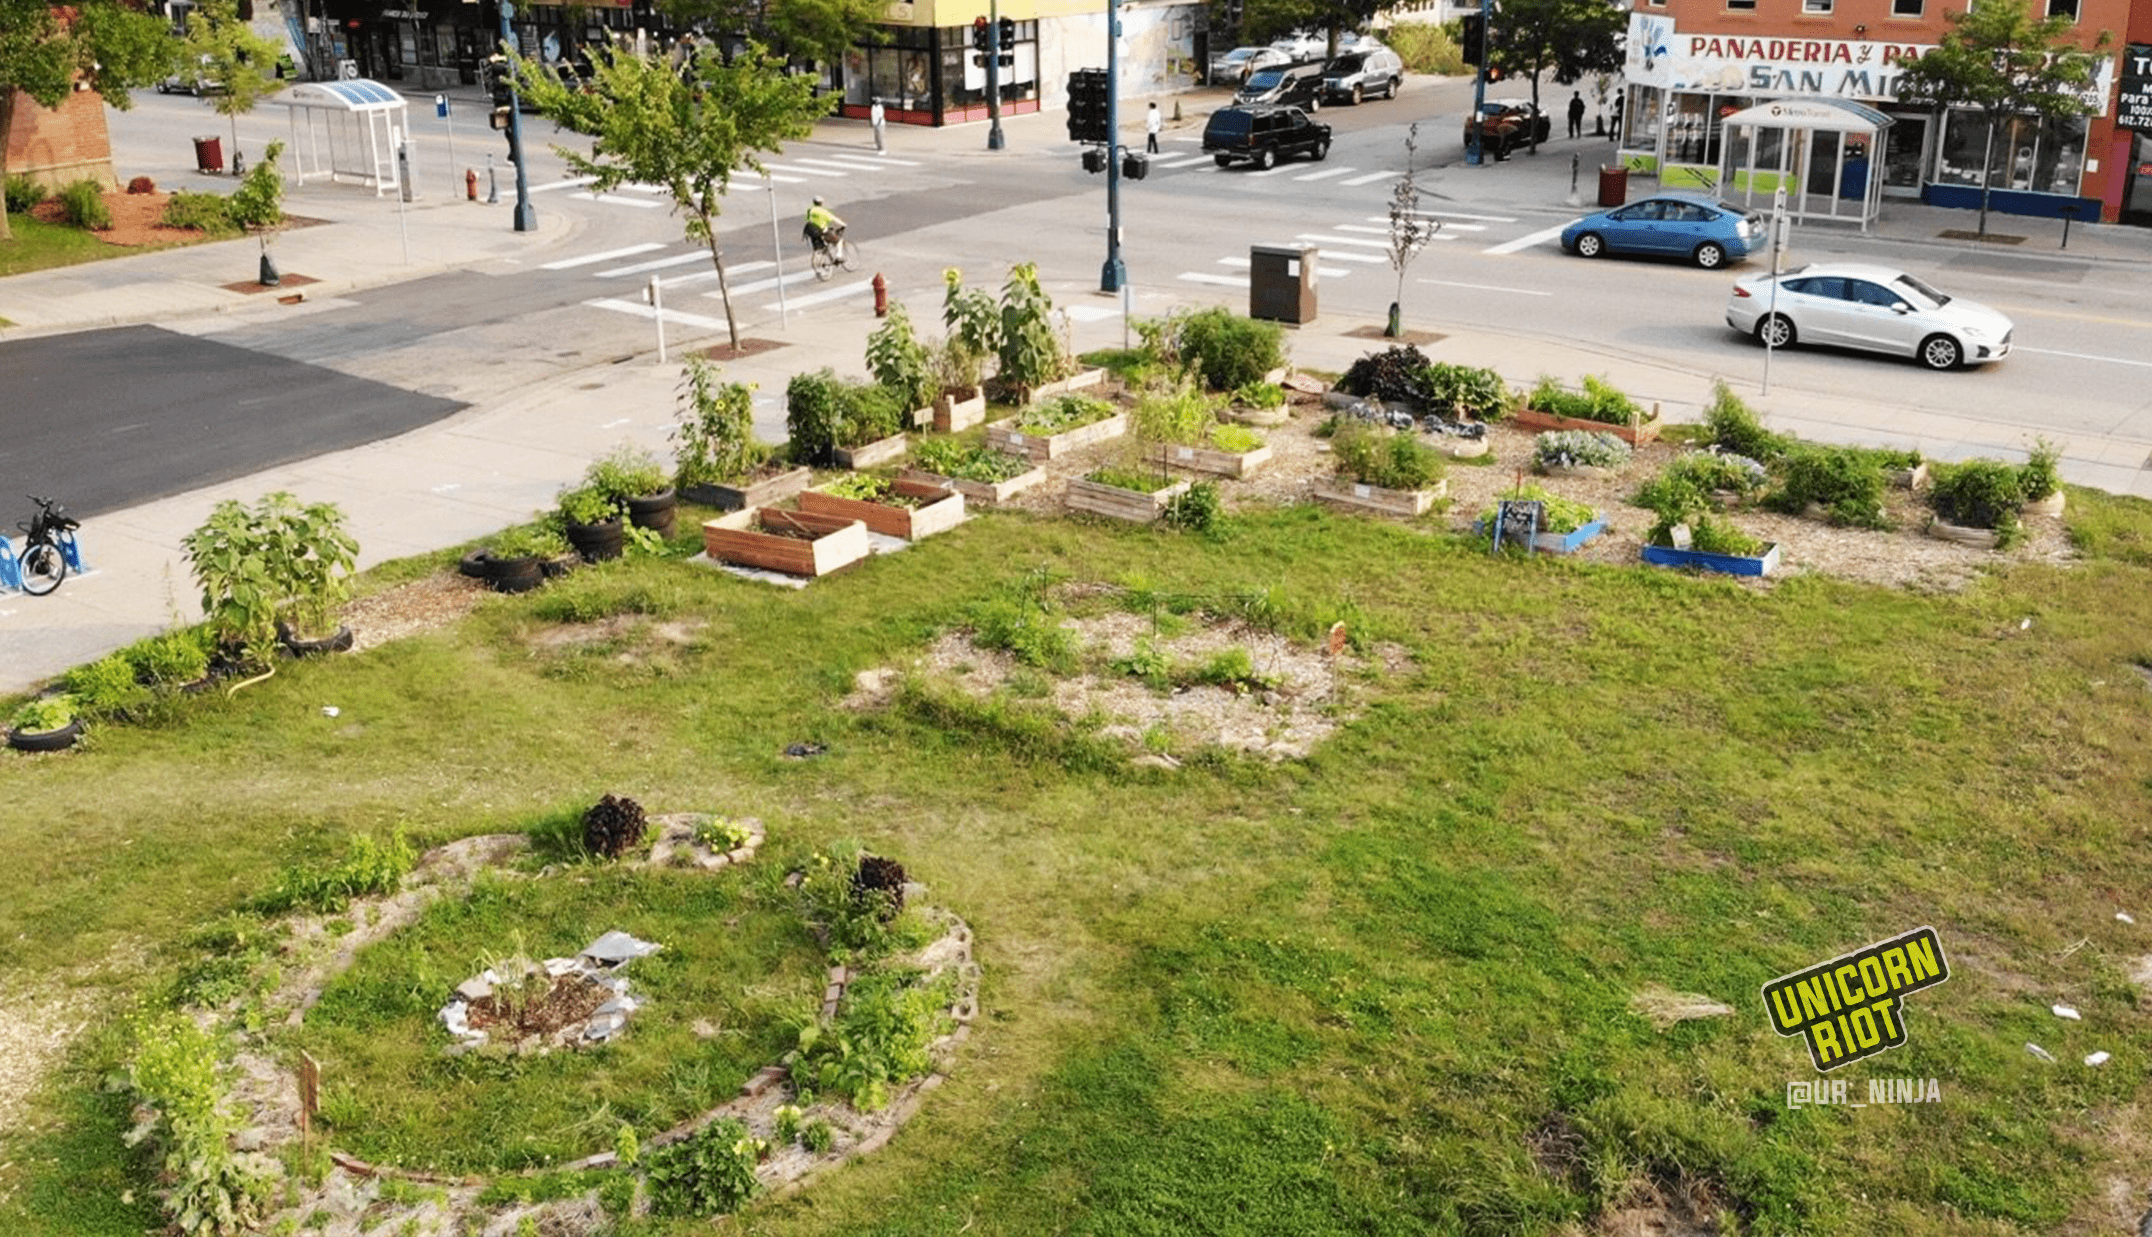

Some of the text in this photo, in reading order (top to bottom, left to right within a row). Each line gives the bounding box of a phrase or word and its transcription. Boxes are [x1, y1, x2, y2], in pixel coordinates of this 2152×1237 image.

[1690, 37, 1852, 64] PANADERIA
[1750, 65, 1823, 93] SAN
[2118, 114, 2152, 127] 612.72
